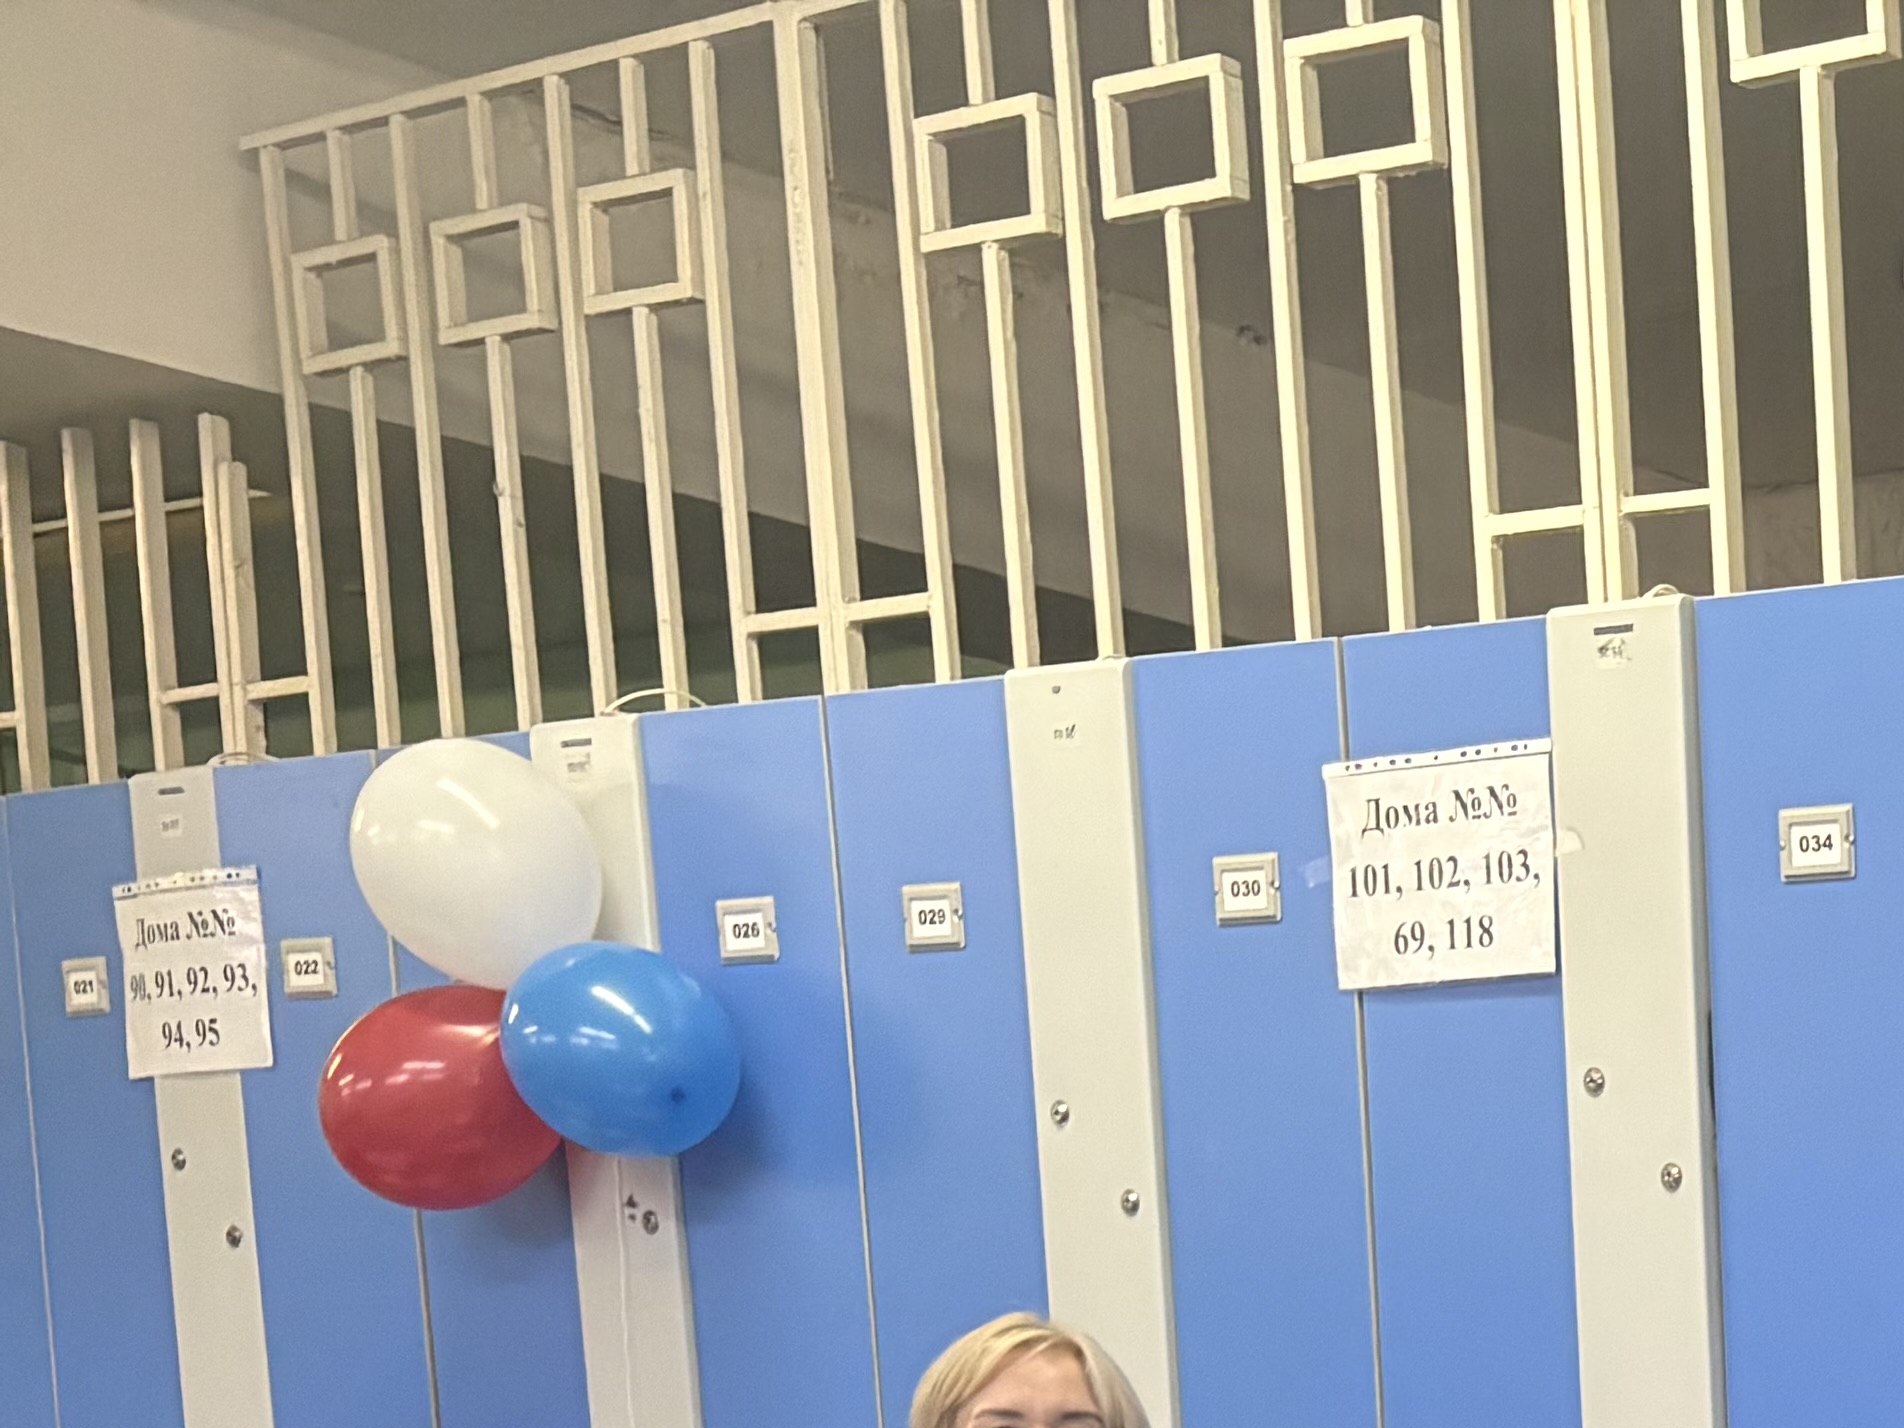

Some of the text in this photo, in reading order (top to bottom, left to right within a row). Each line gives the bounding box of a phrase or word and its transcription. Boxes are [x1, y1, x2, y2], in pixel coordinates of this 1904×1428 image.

[1360, 797, 1439, 839] Дома
[1798, 834, 1834, 853] 034
[1230, 879, 1262, 898] 030
[1350, 847, 1541, 899] 101, 102, 103,
[134, 917, 180, 951] Дома
[917, 908, 946, 926] 029
[1393, 914, 1495, 960] 69, 118
[154, 968, 183, 1001] 91,
[186, 965, 219, 1000] 92,
[223, 962, 258, 998] 93,
[293, 959, 320, 976] 022
[73, 979, 95, 995] 021
[161, 1017, 221, 1053] 94, 95
